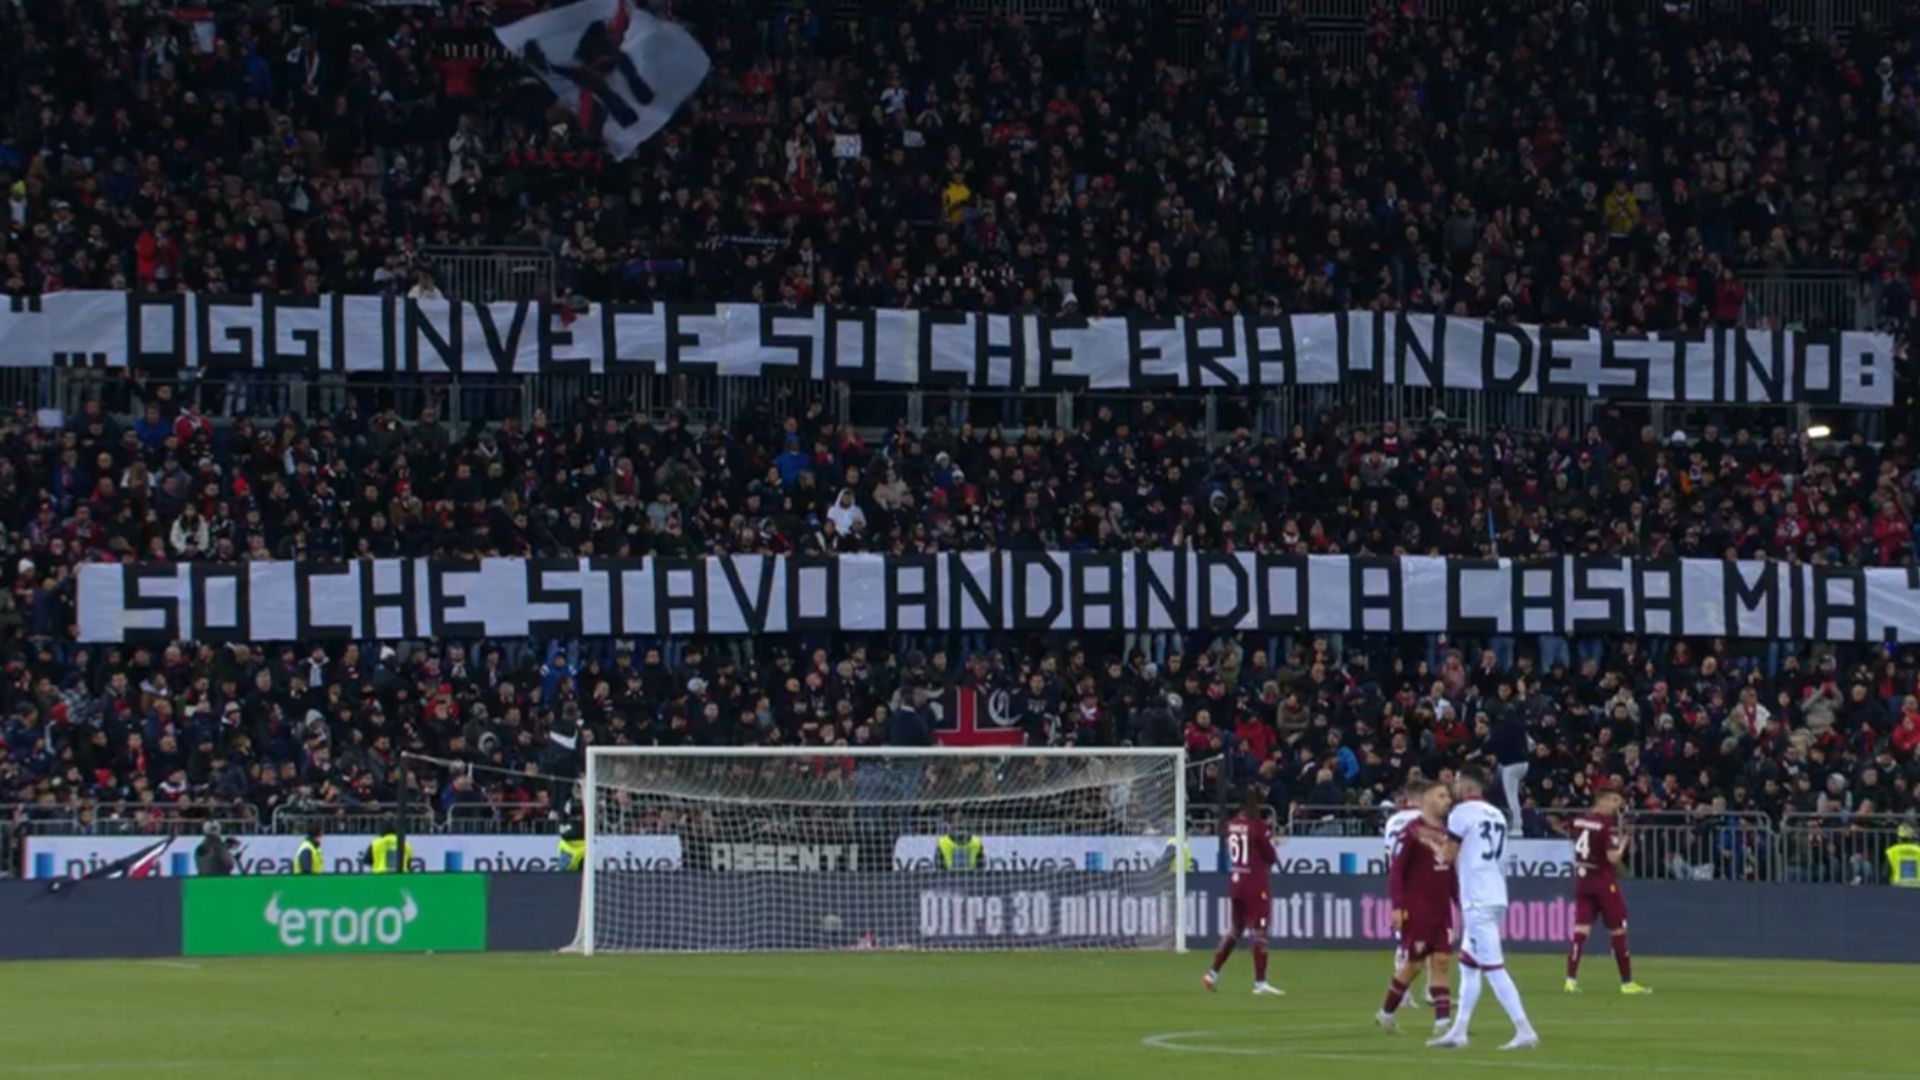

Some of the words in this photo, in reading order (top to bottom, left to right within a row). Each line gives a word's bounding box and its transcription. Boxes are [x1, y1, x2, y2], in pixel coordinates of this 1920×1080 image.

[382, 296, 716, 373] INVECE
[760, 303, 876, 380] SO
[918, 308, 1090, 388] CHE
[1128, 313, 1294, 388] ERA
[1337, 312, 1446, 386] UN
[123, 562, 248, 641] SO
[295, 558, 484, 639] CHE
[527, 557, 839, 635] STAVO
[885, 553, 1309, 632] ANDANDO
[1350, 556, 1403, 632] A
[1447, 557, 1683, 636] CASA
[1228, 833, 1249, 865] 61
[1479, 820, 1505, 861] 37
[1575, 829, 1590, 860] 4
[989, 851, 1077, 873] nivea
[921, 890, 1001, 936] Oltre
[1013, 891, 1050, 936] 30
[1060, 890, 1169, 936] milioni
[1323, 892, 1353, 938] in
